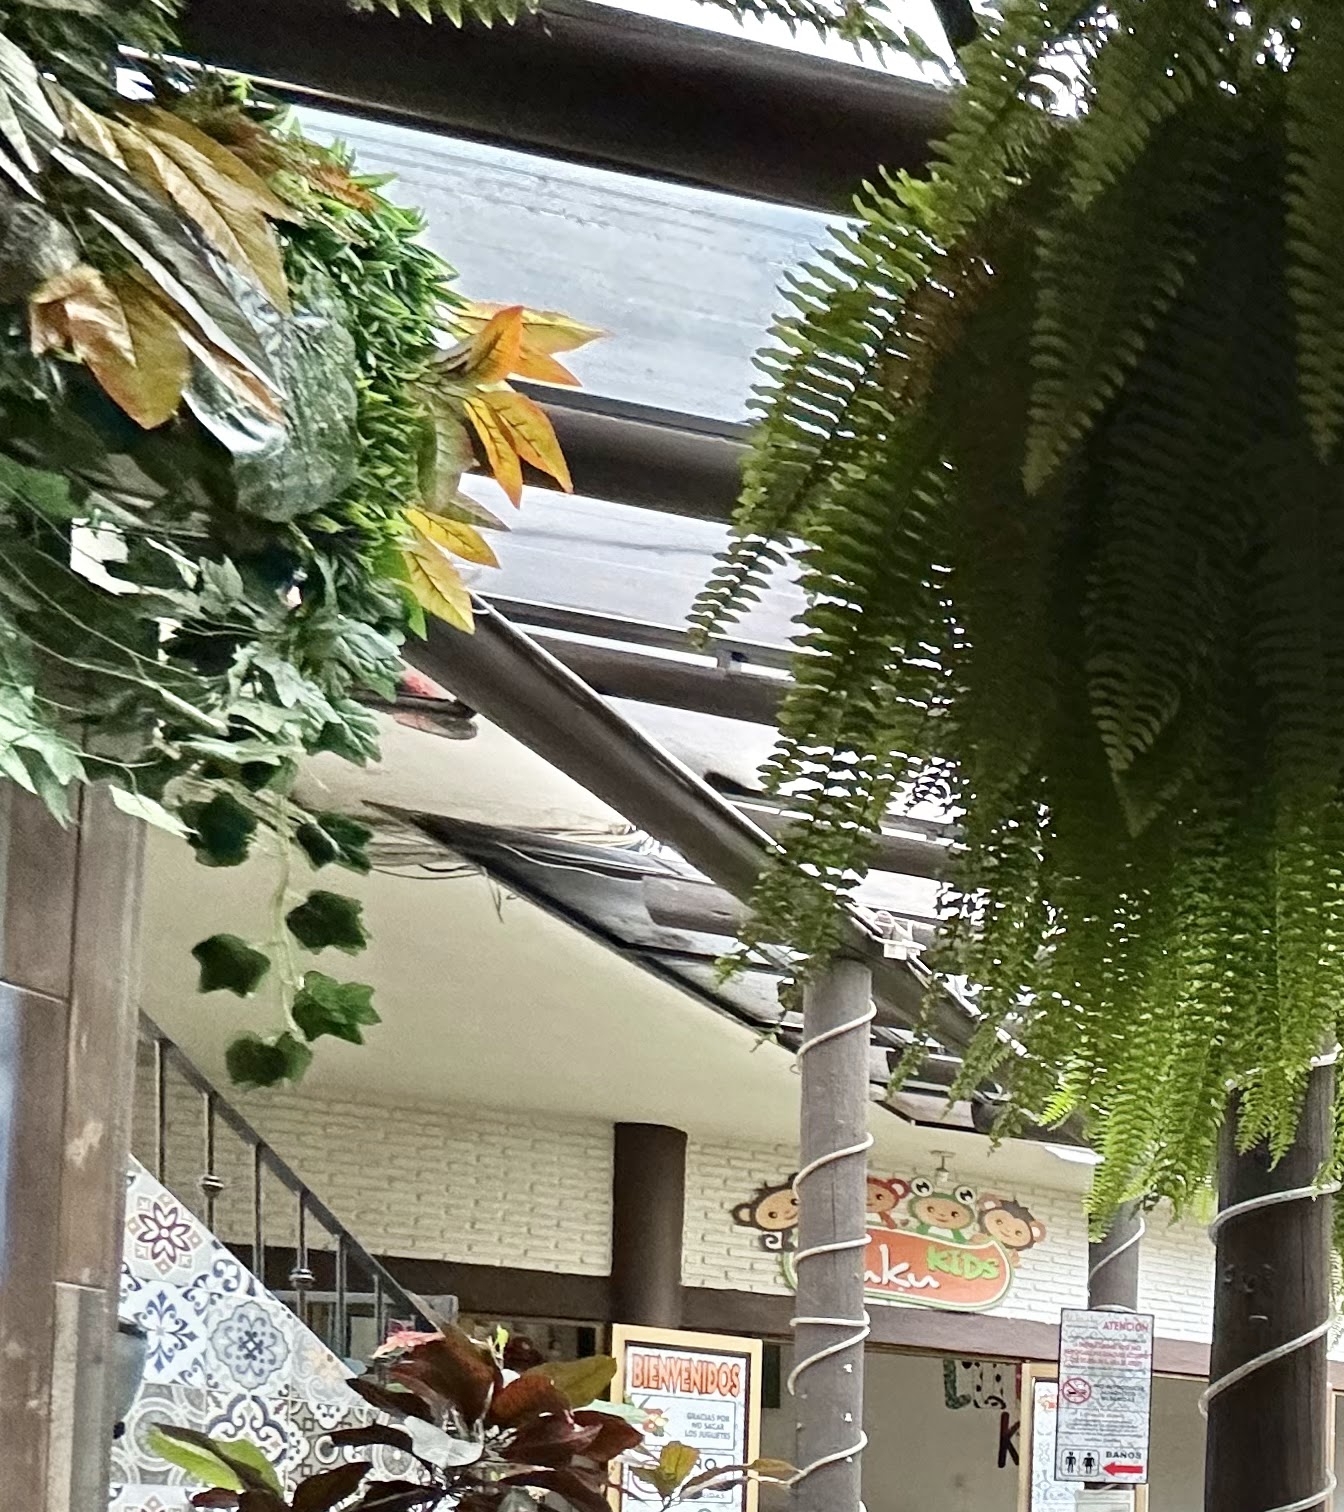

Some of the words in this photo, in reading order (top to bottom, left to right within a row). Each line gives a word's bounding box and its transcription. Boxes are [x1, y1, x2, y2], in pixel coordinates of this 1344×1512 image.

[631, 1353, 741, 1398] BIENVENIDOS
[686, 1412, 716, 1422] GRACIAS
[684, 1429, 698, 1438] LOS
[699, 1430, 731, 1441] JUGUETES
